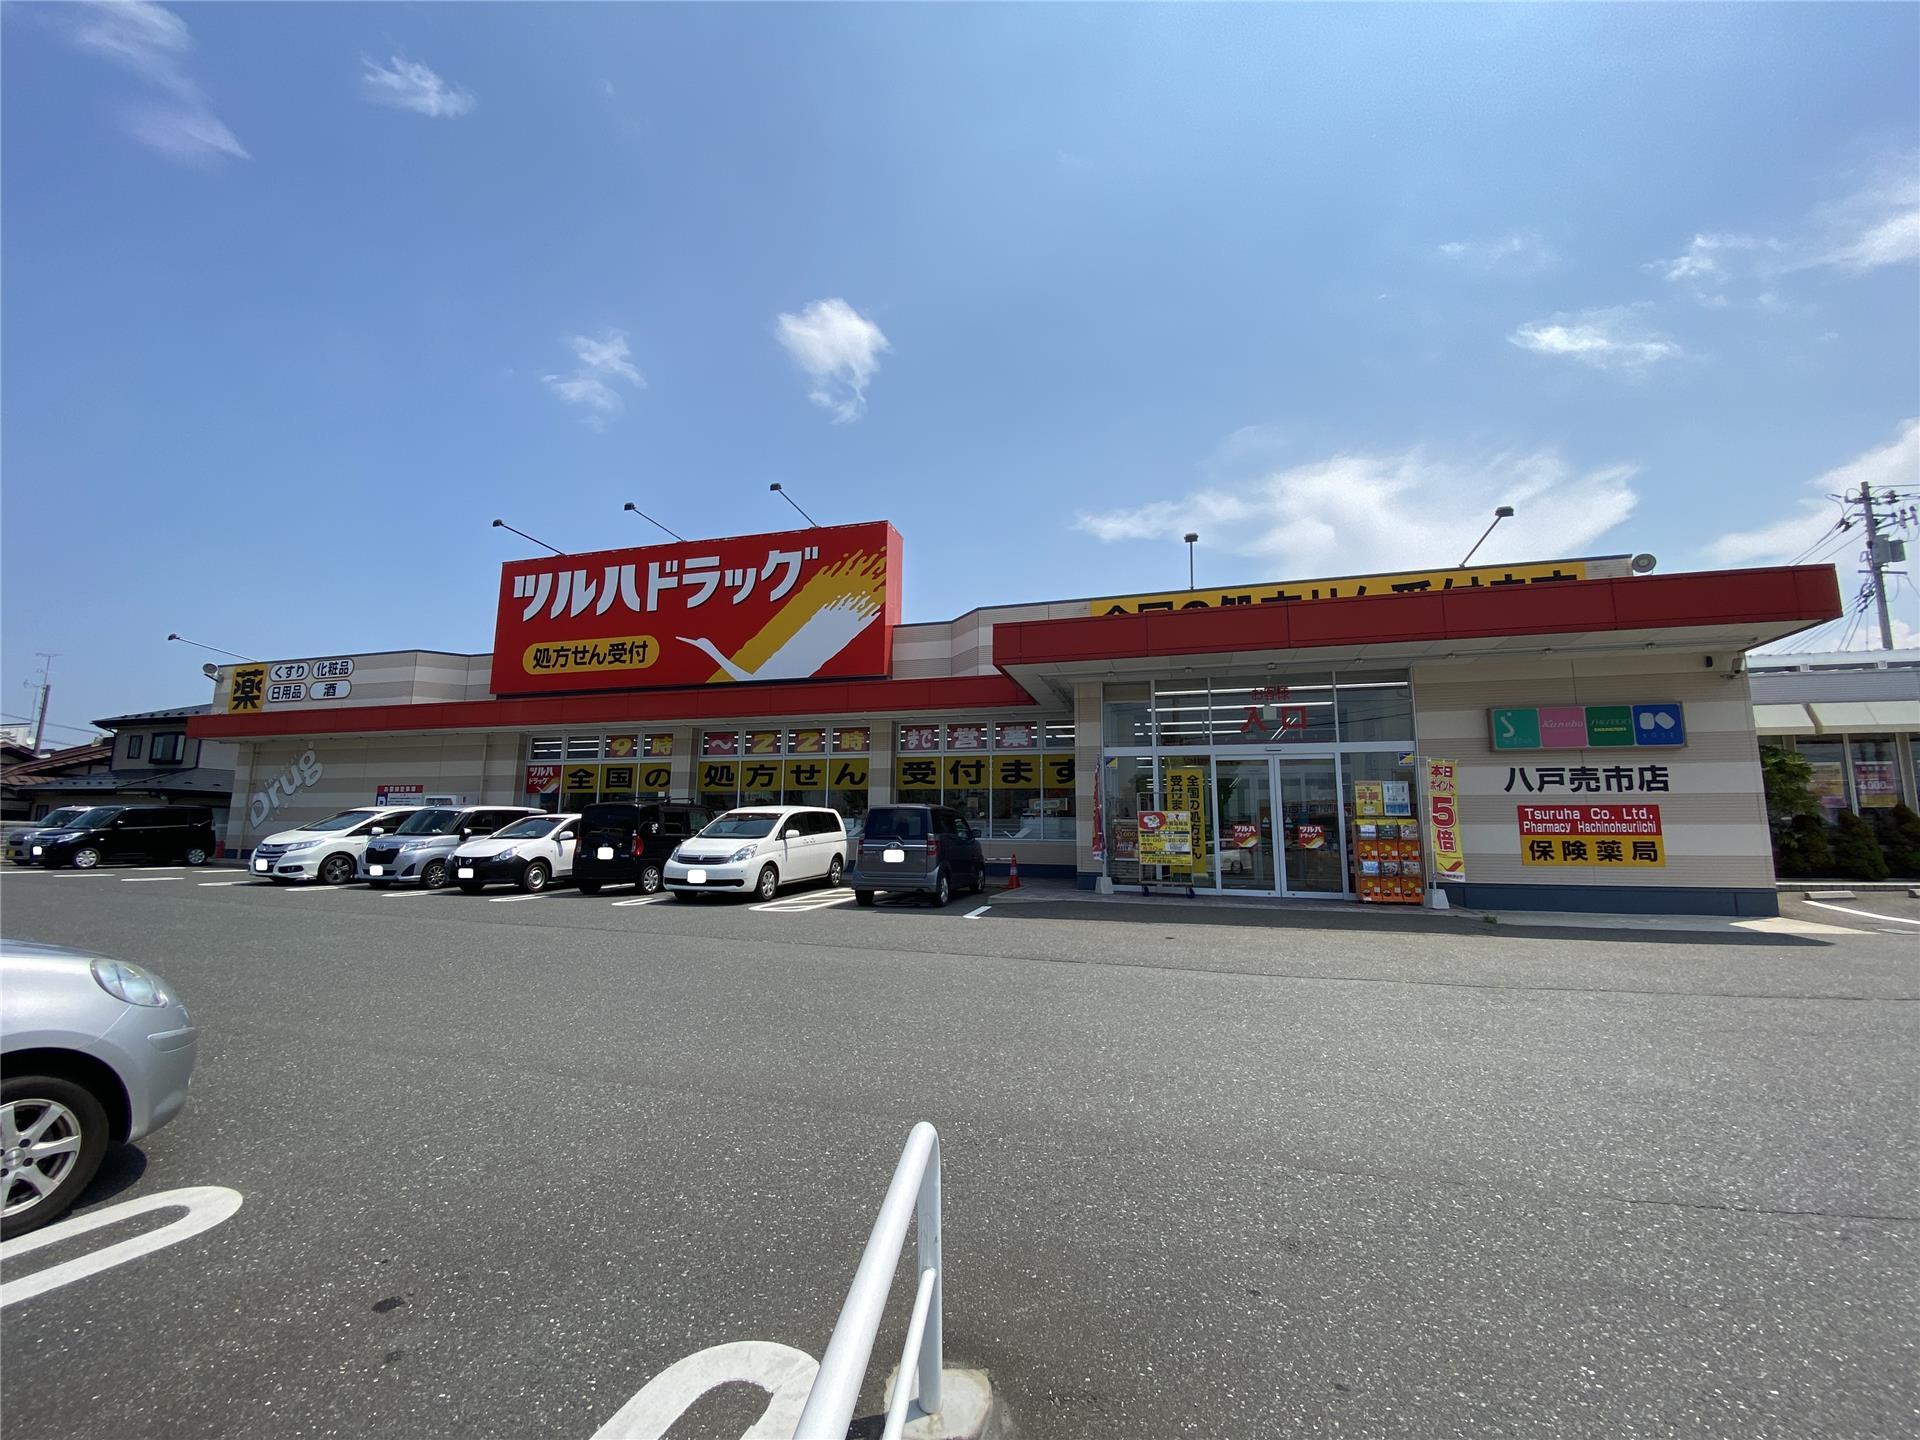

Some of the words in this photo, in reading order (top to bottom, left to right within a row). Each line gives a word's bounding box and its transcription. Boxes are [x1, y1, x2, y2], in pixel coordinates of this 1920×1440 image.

[513, 546, 820, 622] ツルハドラッグ
[532, 638, 649, 670] 処方せん受付
[272, 663, 306, 679] くすり
[316, 660, 350, 677] 化粧品
[231, 668, 264, 710] 薬
[270, 684, 303, 700] 日用品
[323, 683, 338, 698] 酒
[1240, 706, 1308, 732] 入口
[1542, 718, 1584, 729] Kanebo
[906, 727, 1029, 750] まで営業
[528, 777, 550, 785] ドラッグ
[529, 767, 554, 777] ツルハ
[567, 768, 671, 790] 全国の
[703, 763, 867, 788] 処方せん
[902, 760, 1076, 785] 受付ます
[1431, 764, 1453, 778] 本日
[1504, 765, 1670, 793] 八戸売市店
[250, 750, 324, 828] Drug
[1430, 780, 1454, 792] ポイント
[1431, 795, 1456, 828] 5
[1525, 807, 1580, 820] Tsuruha
[1590, 807, 1616, 820] Co.
[1234, 825, 1256, 833] ツルハ
[1523, 821, 1571, 834] Pharmacy
[1578, 820, 1657, 833] Hachinoheuriichi
[1437, 829, 1456, 853] 倍
[1528, 839, 1659, 863] 保険薬局
